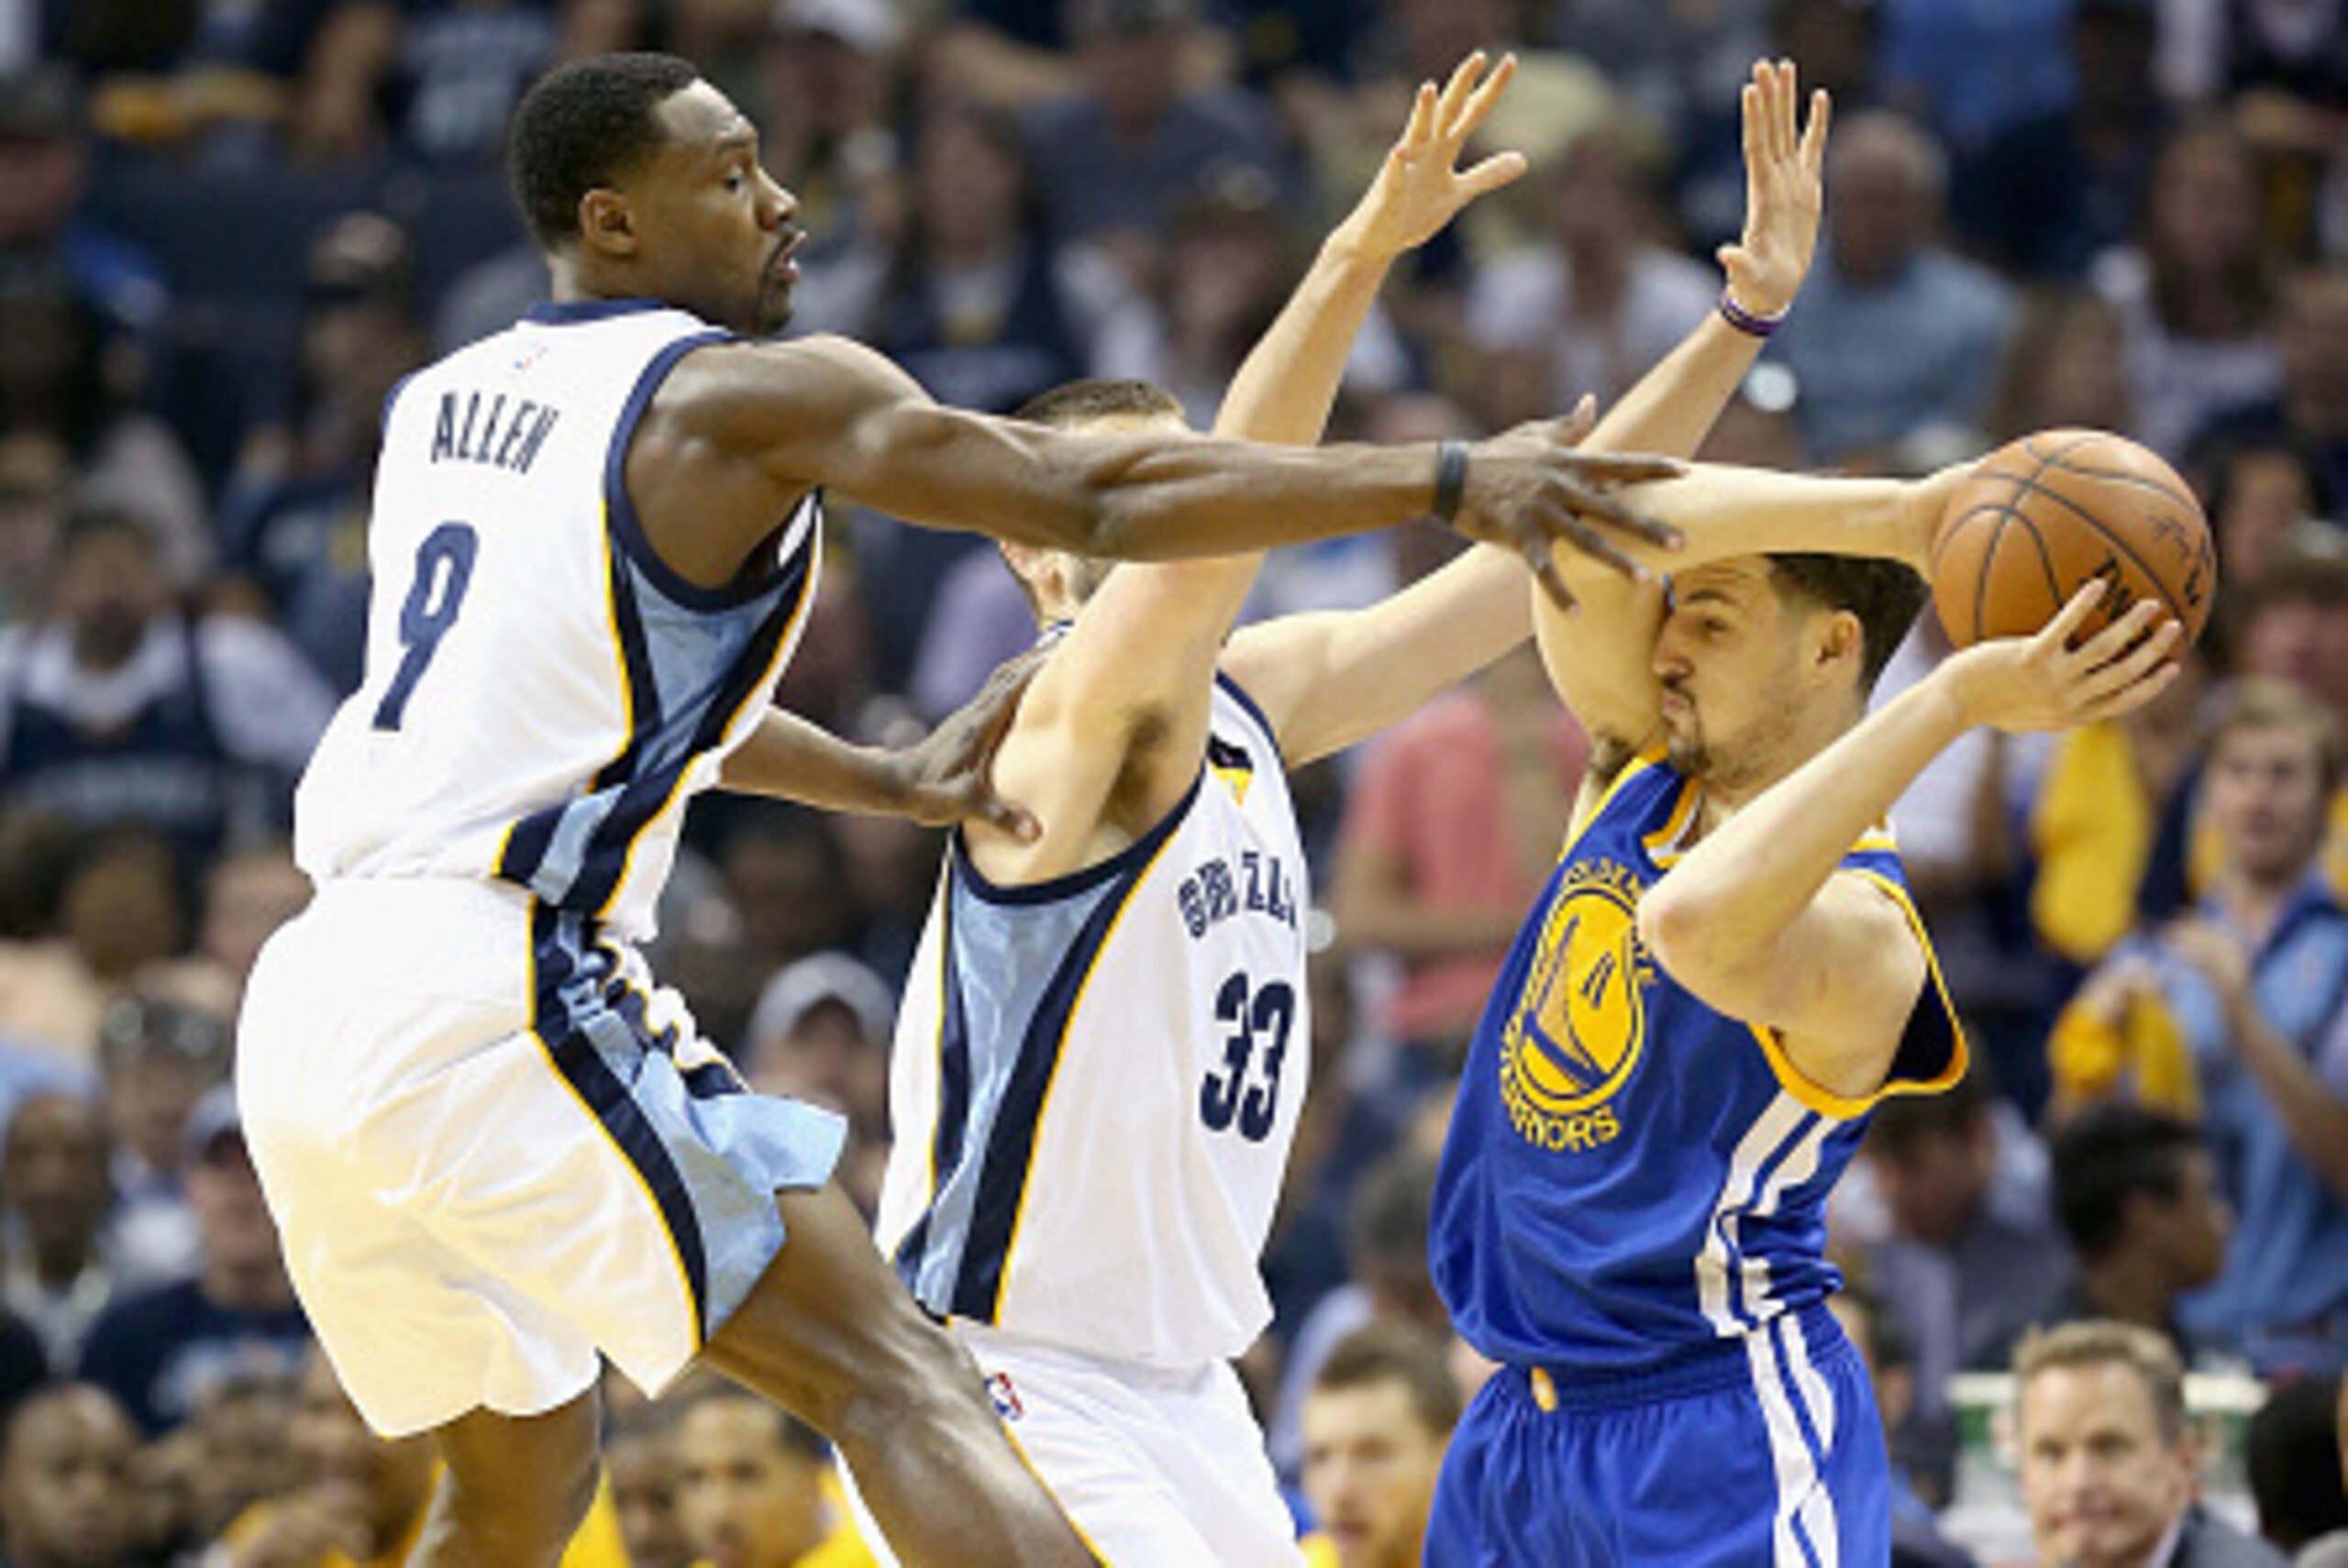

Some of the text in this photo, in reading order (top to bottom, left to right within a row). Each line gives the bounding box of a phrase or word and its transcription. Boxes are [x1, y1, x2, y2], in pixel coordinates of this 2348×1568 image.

[430, 390, 558, 474] ALLEN
[371, 520, 480, 732] 9
[1201, 971, 1295, 1142] 33
